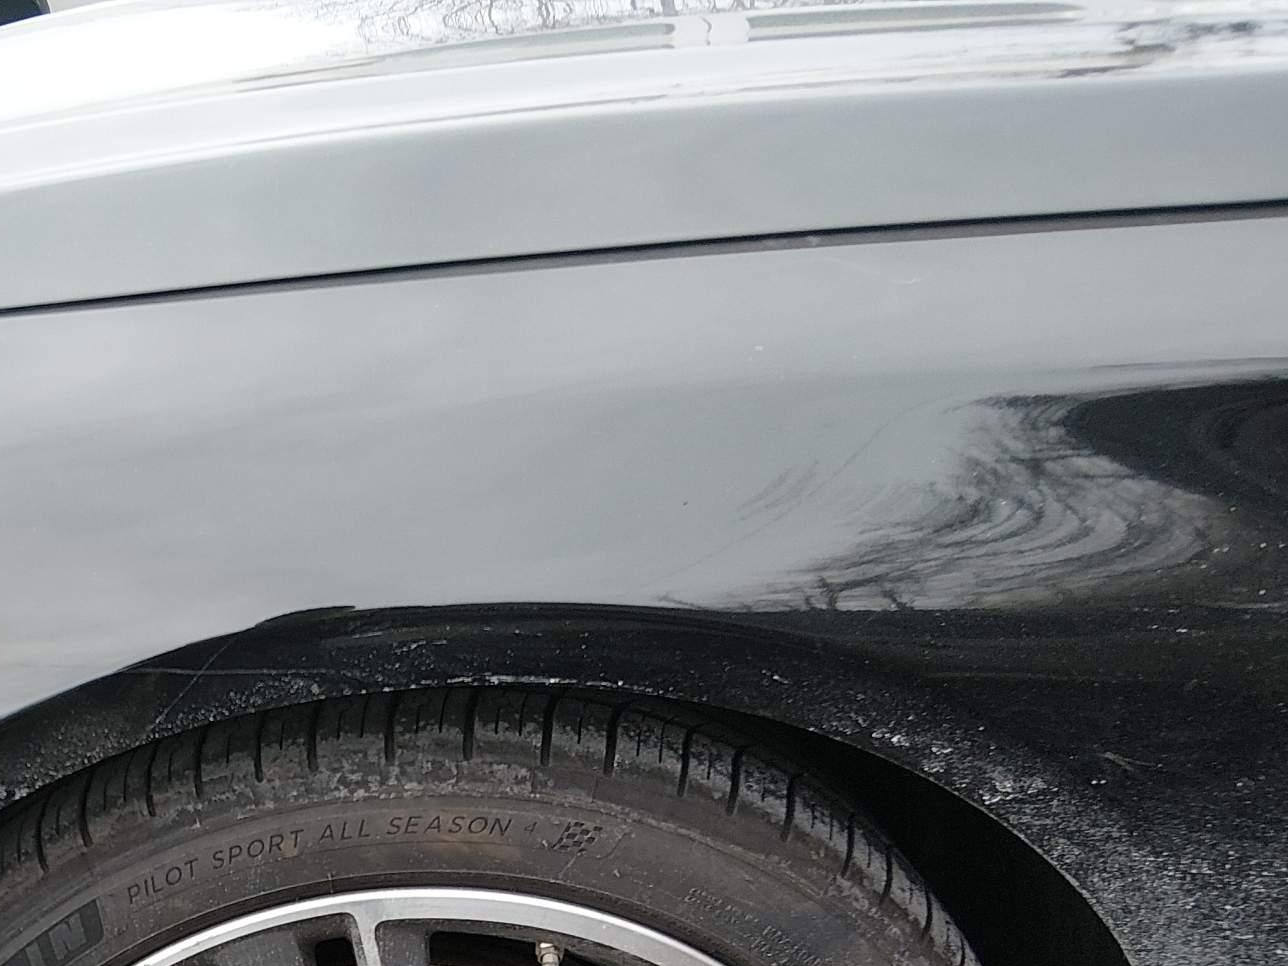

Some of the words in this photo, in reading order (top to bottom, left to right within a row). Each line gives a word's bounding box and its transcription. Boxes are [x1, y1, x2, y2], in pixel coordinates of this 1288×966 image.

[127, 858, 199, 904] PILOT
[212, 829, 305, 869] SPORT
[319, 818, 370, 842] ALL
[386, 815, 511, 836] SEASON
